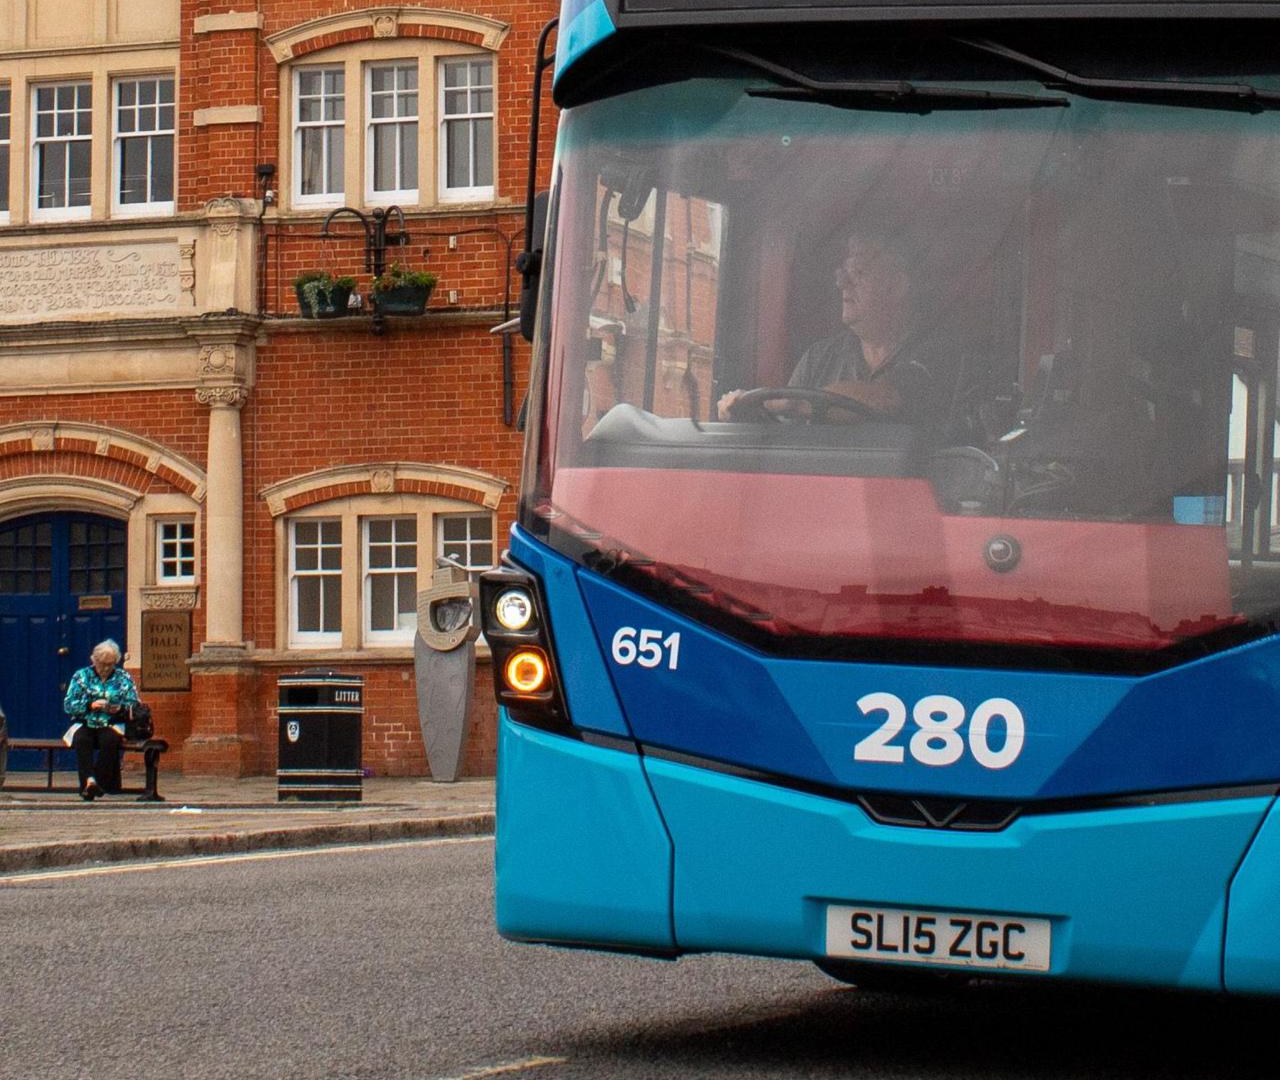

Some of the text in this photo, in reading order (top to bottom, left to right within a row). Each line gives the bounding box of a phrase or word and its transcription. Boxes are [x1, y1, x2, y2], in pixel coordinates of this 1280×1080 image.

[150, 623, 183, 634] TOWN
[150, 637, 181, 647] HALL
[611, 626, 680, 670] 651
[335, 690, 360, 702] LITTER
[854, 691, 1025, 769] 280
[850, 912, 1026, 962] SL15 ZGC
